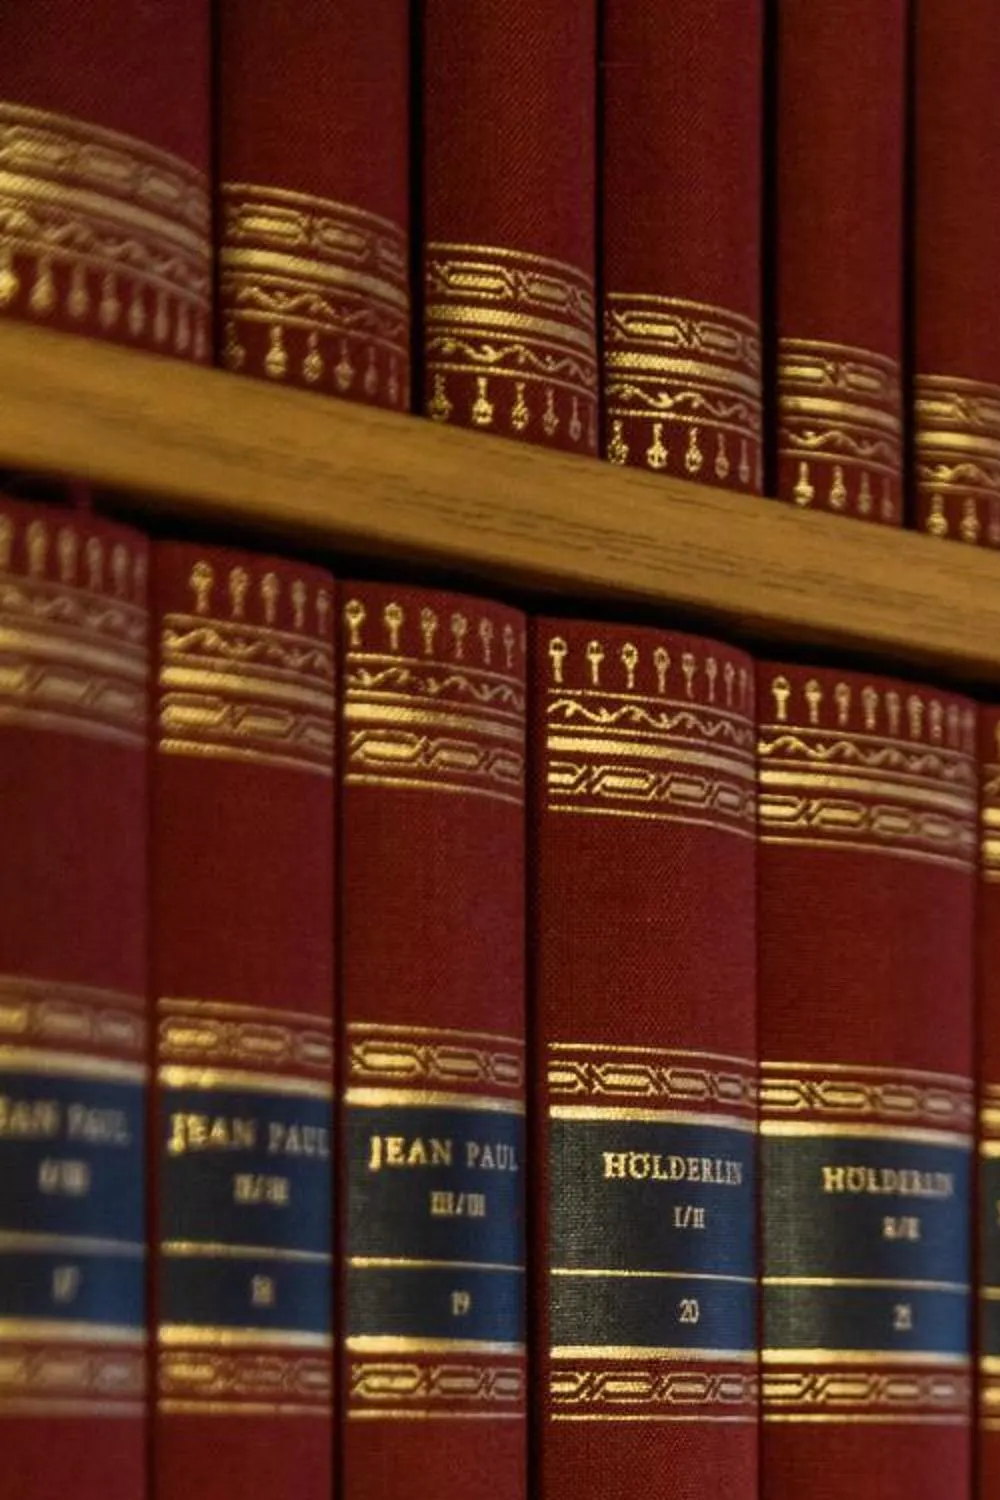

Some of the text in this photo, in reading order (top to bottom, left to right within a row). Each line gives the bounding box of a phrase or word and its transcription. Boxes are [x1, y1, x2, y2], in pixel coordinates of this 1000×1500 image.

[168, 1111, 330, 1160] JEAN PAUL
[369, 1135, 519, 1172] JEAN PAUL
[673, 1204, 706, 1229] I/II
